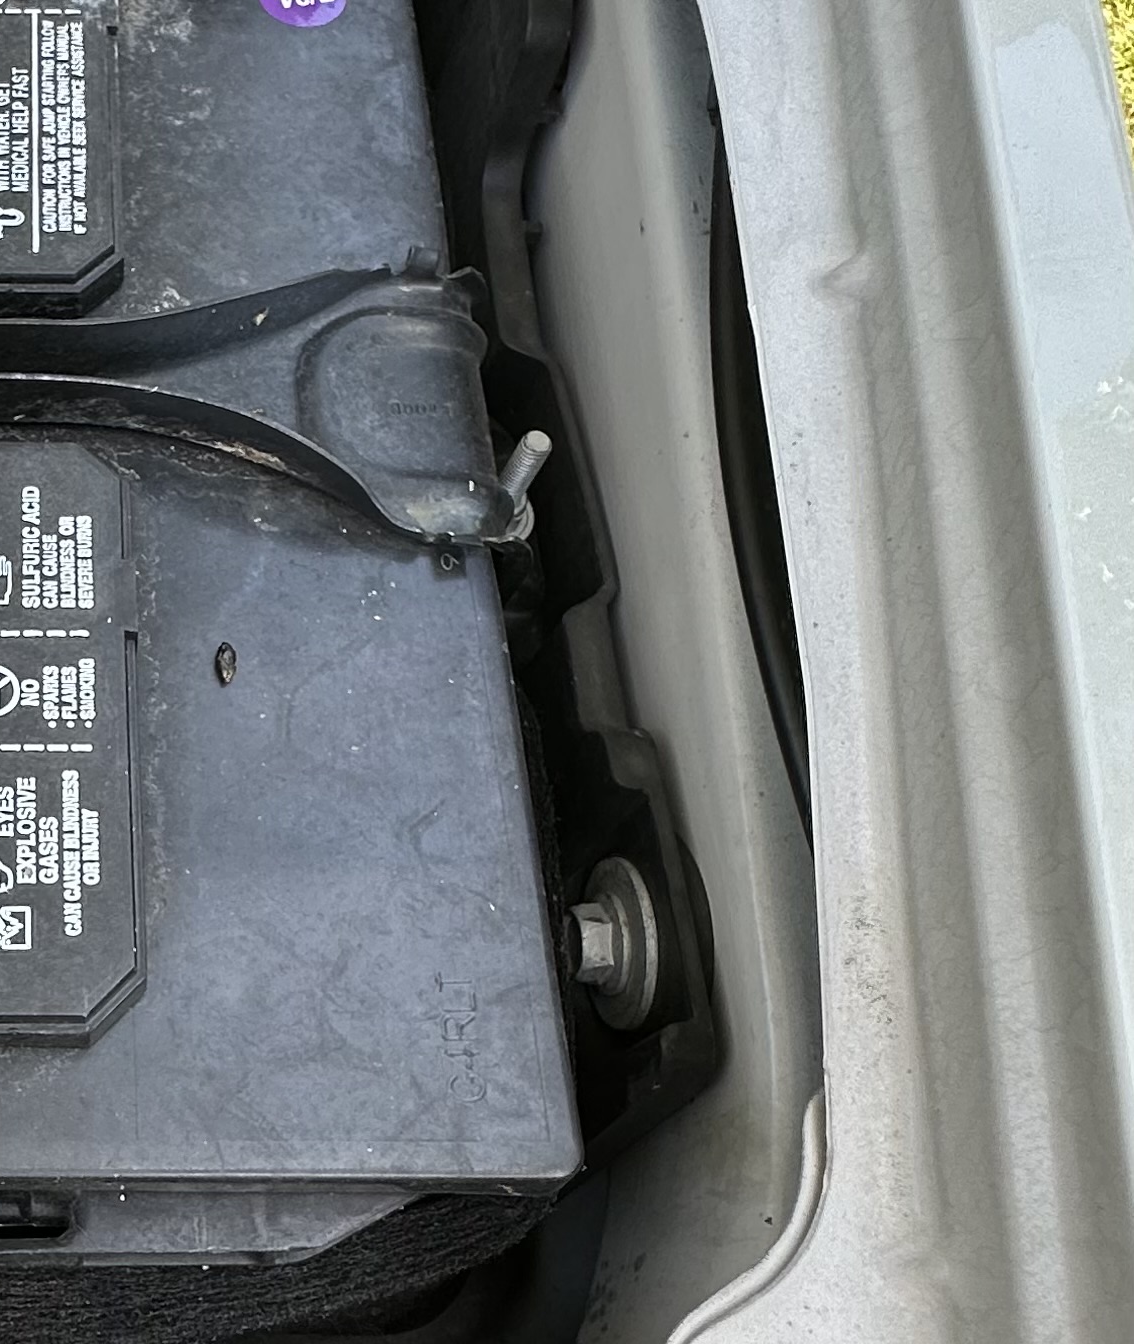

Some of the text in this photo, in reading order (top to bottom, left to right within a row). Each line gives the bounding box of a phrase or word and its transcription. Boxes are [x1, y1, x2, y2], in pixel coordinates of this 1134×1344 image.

[42, 20, 55, 57] FOLLOW
[42, 59, 55, 106] STARTING
[11, 67, 29, 192] MEDICAL HELP FAST
[42, 107, 55, 134] JUMP
[43, 137, 56, 161] SAFE
[57, 106, 70, 145] VEHICLE
[58, 147, 70, 158] IN
[71, 22, 86, 234] IF NOT AVAILABLE SEEK SERVICE ASSISTANCE
[43, 163, 56, 184] FOR
[57, 160, 72, 231] INSTRUCTIONS
[22, 486, 40, 608] SULFURIC ACID
[42, 534, 58, 608] CAN CAUSE
[59, 516, 76, 608] BLINDNESS OR
[76, 516, 94, 608] SEVERE BURNS
[20, 679, 40, 706] NO
[16, 777, 36, 884] EXPLOSIVE
[38, 816, 59, 884] GASES
[62, 770, 82, 936] CAN CAUSE BLINDNESS
[81, 808, 100, 886] OR INJURY
